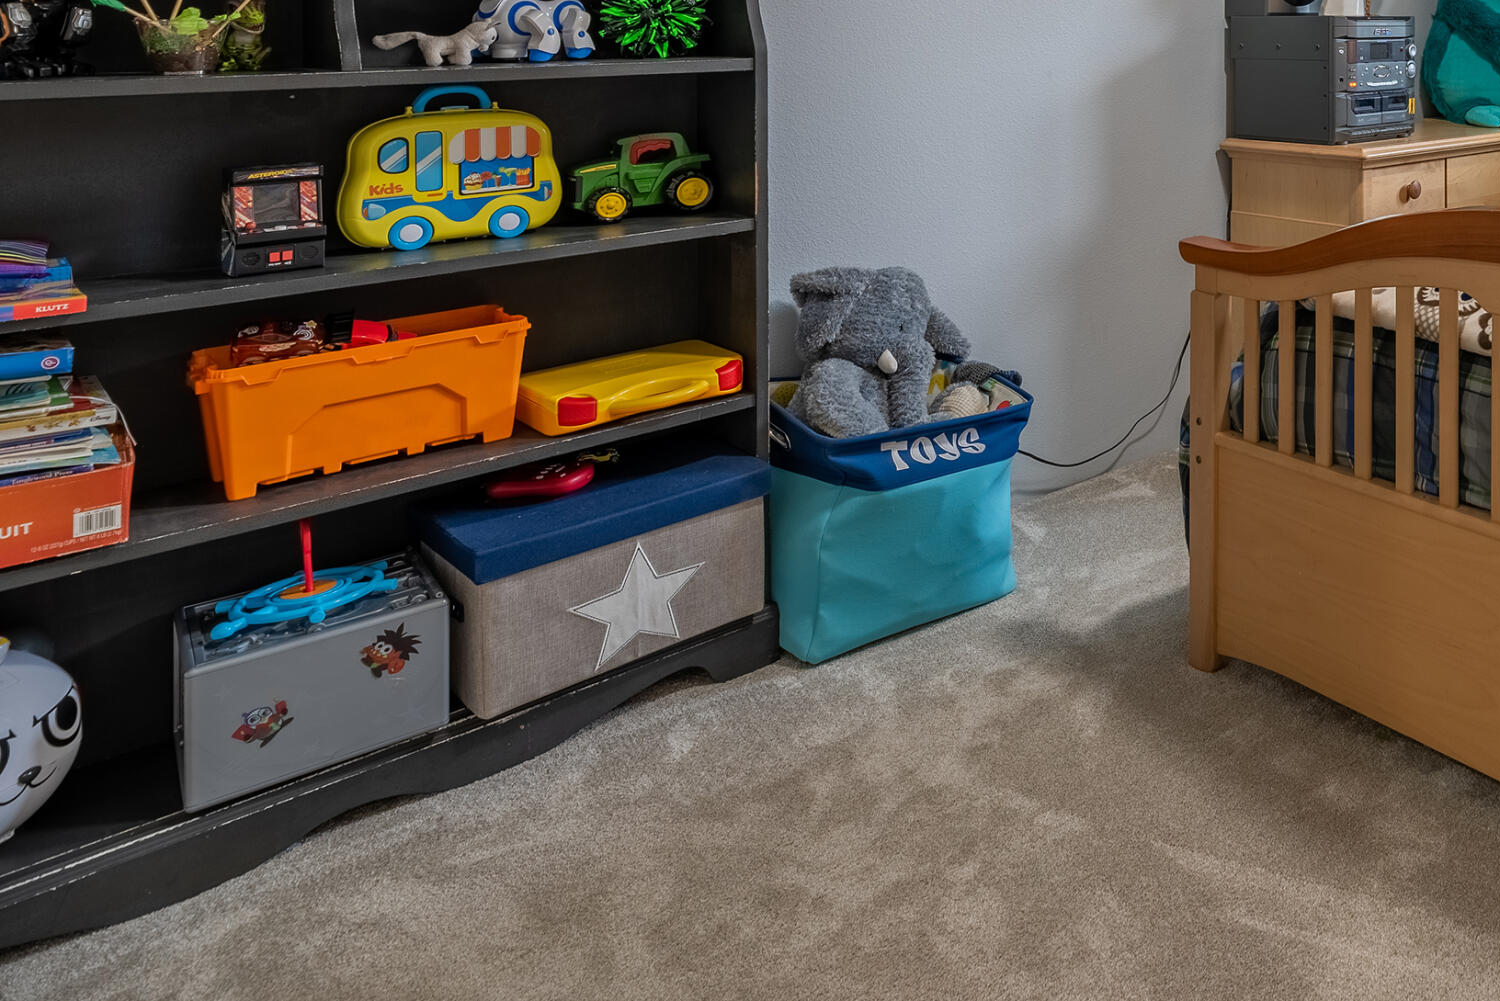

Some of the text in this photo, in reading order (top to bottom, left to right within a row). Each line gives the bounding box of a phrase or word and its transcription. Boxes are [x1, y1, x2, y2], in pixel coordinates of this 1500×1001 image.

[369, 182, 404, 196] Kids
[35, 304, 69, 312] KLUTZ
[881, 428, 986, 471] TOYS
